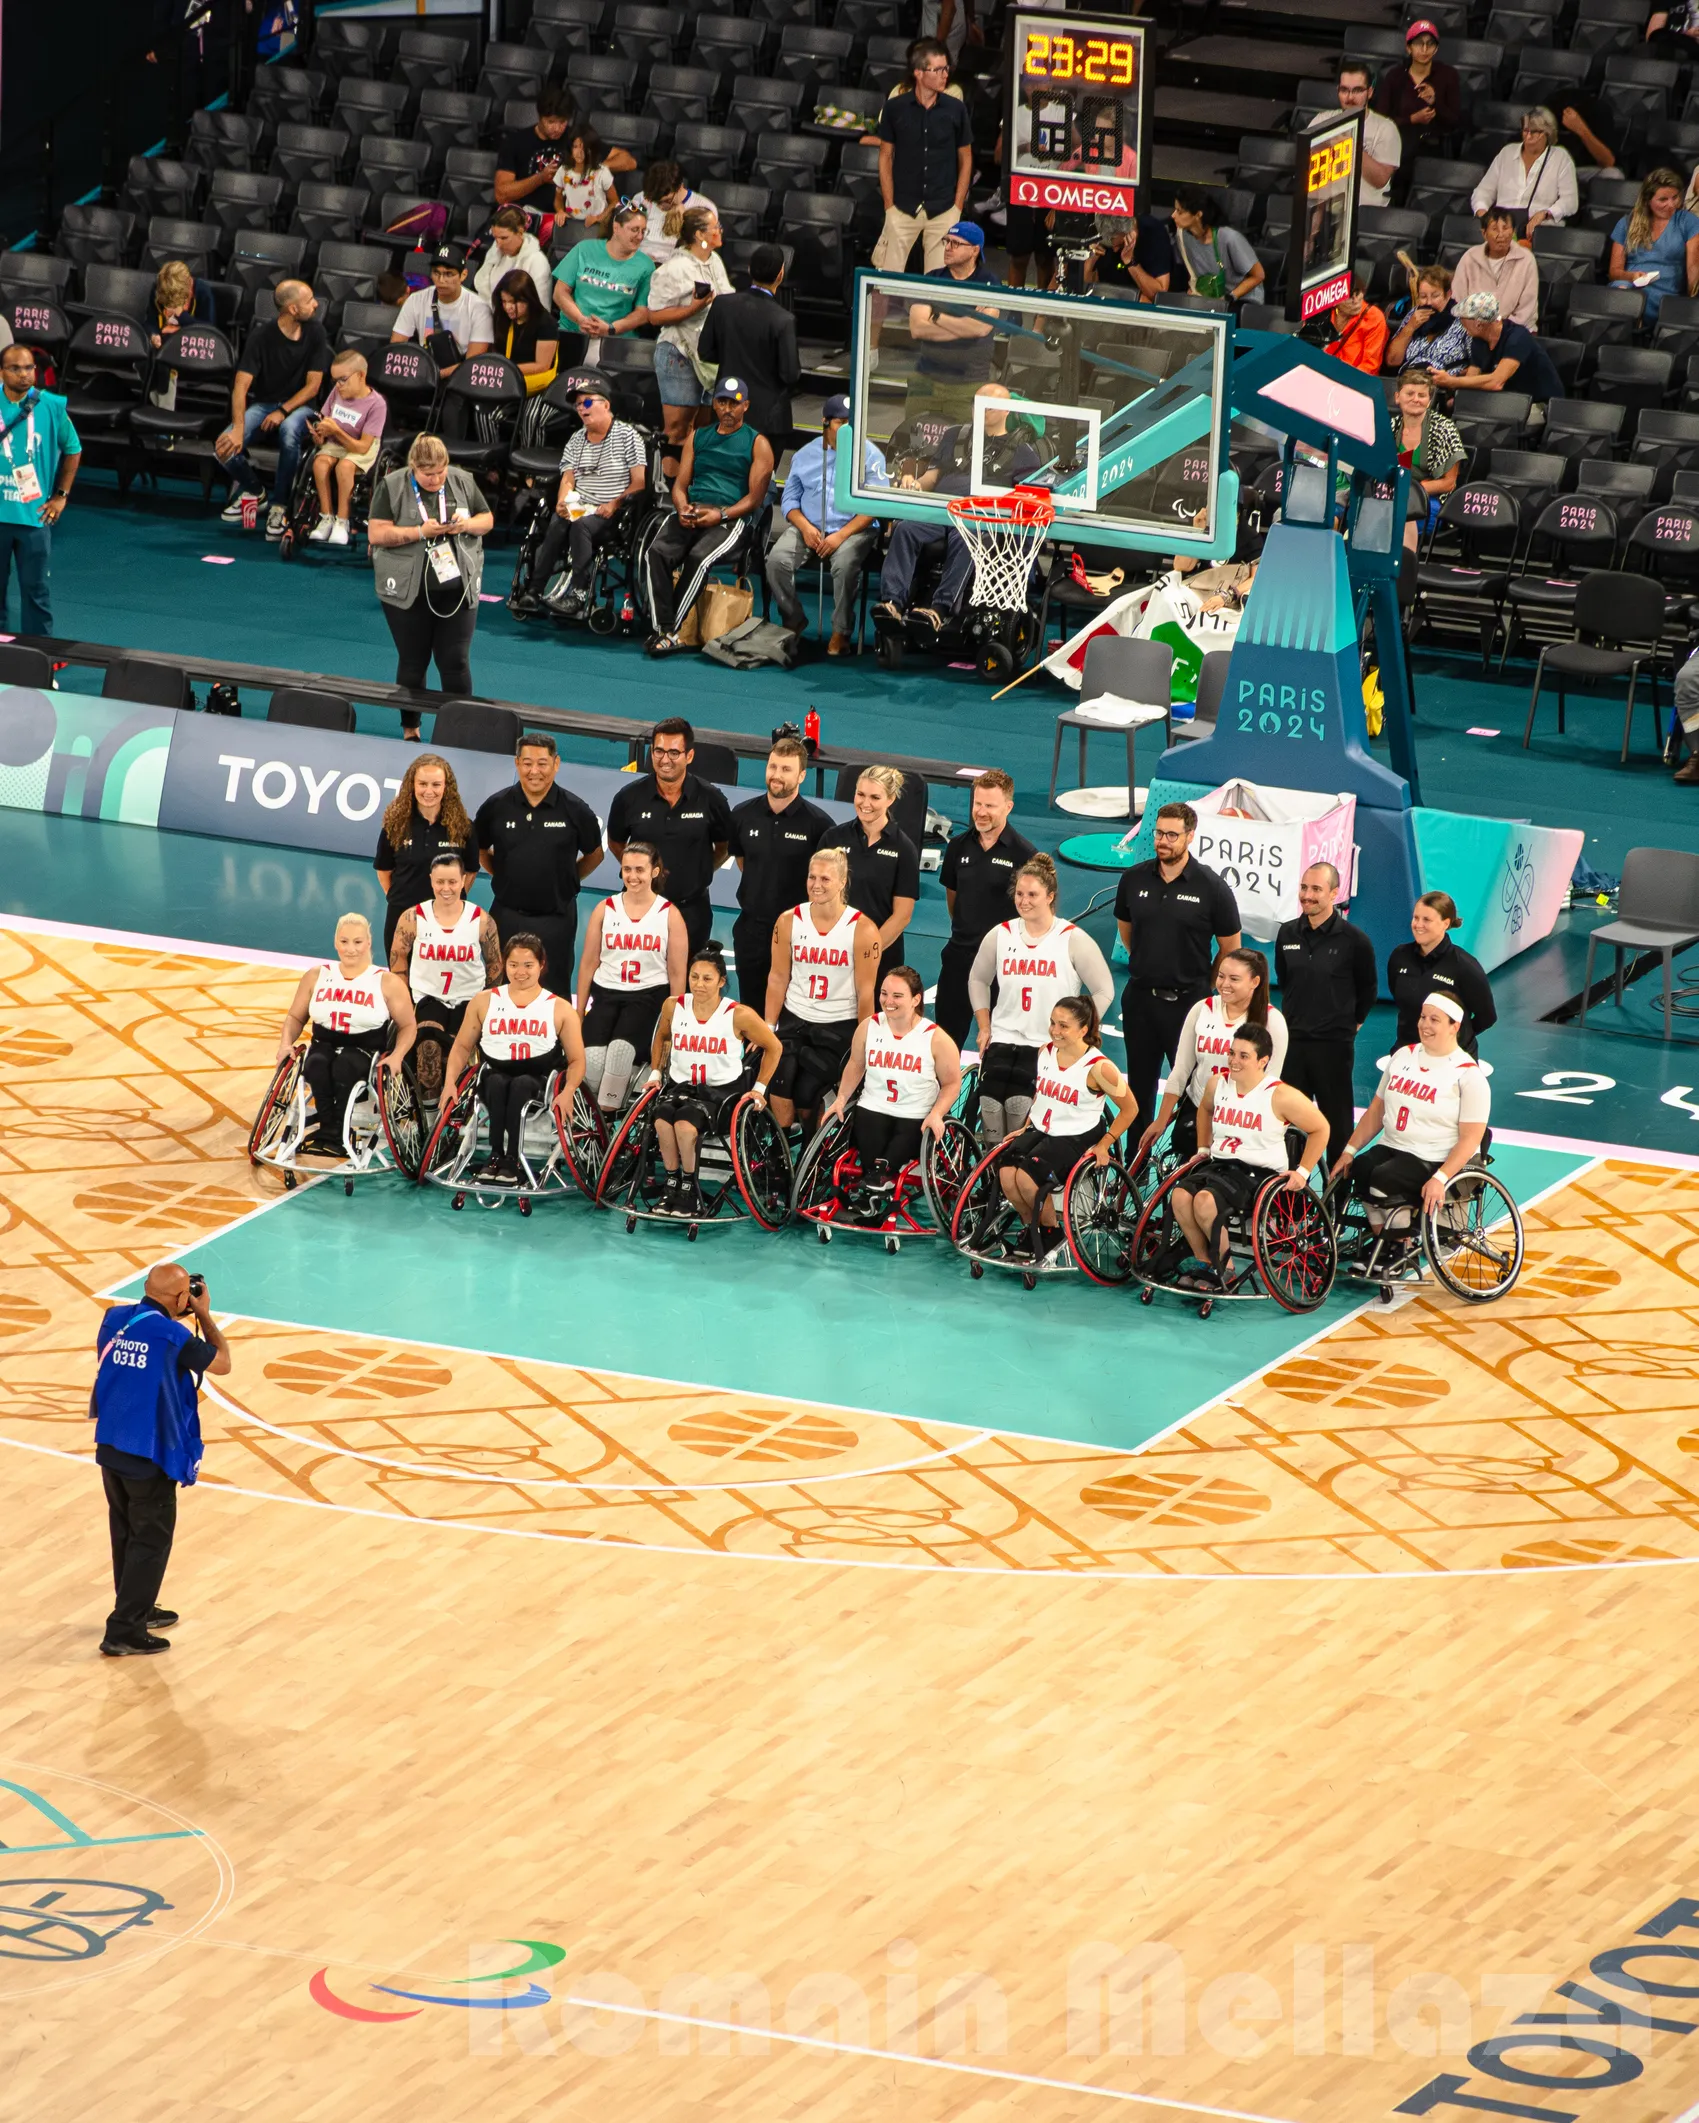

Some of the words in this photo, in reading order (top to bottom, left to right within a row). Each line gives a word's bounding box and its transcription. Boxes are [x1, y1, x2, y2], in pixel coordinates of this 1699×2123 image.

[1025, 33, 1133, 84] 23:29
[1308, 137, 1353, 192] 23:29
[1044, 184, 1128, 212] OMEGA
[584, 267, 611, 278] PARIS
[1315, 278, 1348, 309] OMEGA
[15, 307, 50, 320] PARIS
[15, 319, 49, 331] 2024
[96, 322, 131, 337] PARIS
[95, 334, 130, 348] 2024
[181, 335, 216, 349] PARIS
[180, 347, 214, 360] 2024
[386, 352, 419, 366] PARIS
[384, 364, 418, 378] 2024
[472, 364, 505, 378] PARIS
[470, 375, 503, 389] 2024
[1101, 456, 1134, 489] 2024
[1184, 458, 1208, 470] PAR
[1183, 470, 1209, 483] 202
[1465, 491, 1499, 505] PARIS
[1463, 503, 1497, 517] 2024
[1561, 505, 1597, 519] PARIS
[1560, 516, 1595, 530] 2024
[1657, 516, 1692, 530] PARIS
[1655, 528, 1691, 542] 2024
[1238, 680, 1326, 713] PARIS
[1238, 708, 1326, 741] 2024
[785, 832, 807, 841] CANADA
[876, 848, 898, 858] CANADA
[1199, 835, 1283, 868] PARIS
[991, 857, 1013, 868] CANADA
[1221, 866, 1282, 897] 024
[1176, 894, 1200, 903] CANADA
[419, 942, 475, 962] CANADA
[605, 933, 661, 952] CANADA
[1283, 943, 1301, 951] CANADA
[793, 945, 849, 966] CANADA
[620, 960, 641, 984] 12
[1002, 958, 1057, 978] CANADA
[440, 972, 453, 995] 7
[808, 974, 829, 1000] 13
[1432, 973, 1455, 986] CANADA
[315, 988, 375, 1009] CANADA
[1021, 987, 1032, 1012] 6
[329, 1011, 352, 1034] 15
[489, 1018, 548, 1038] CANADA
[509, 1042, 530, 1060] 10
[673, 1033, 728, 1055] CANADA
[1197, 1035, 1231, 1056] CANA
[868, 1050, 922, 1074] CANADA
[690, 1063, 707, 1085] 11
[886, 1079, 898, 1103] 5
[1036, 1076, 1079, 1107] CANADA
[1388, 1075, 1438, 1105] CANADA
[1042, 1108, 1053, 1133] 4
[1213, 1105, 1262, 1132] CANADA
[1396, 1106, 1409, 1132] 8
[115, 1339, 149, 1354] PHOTO
[112, 1349, 147, 1369] 0318
